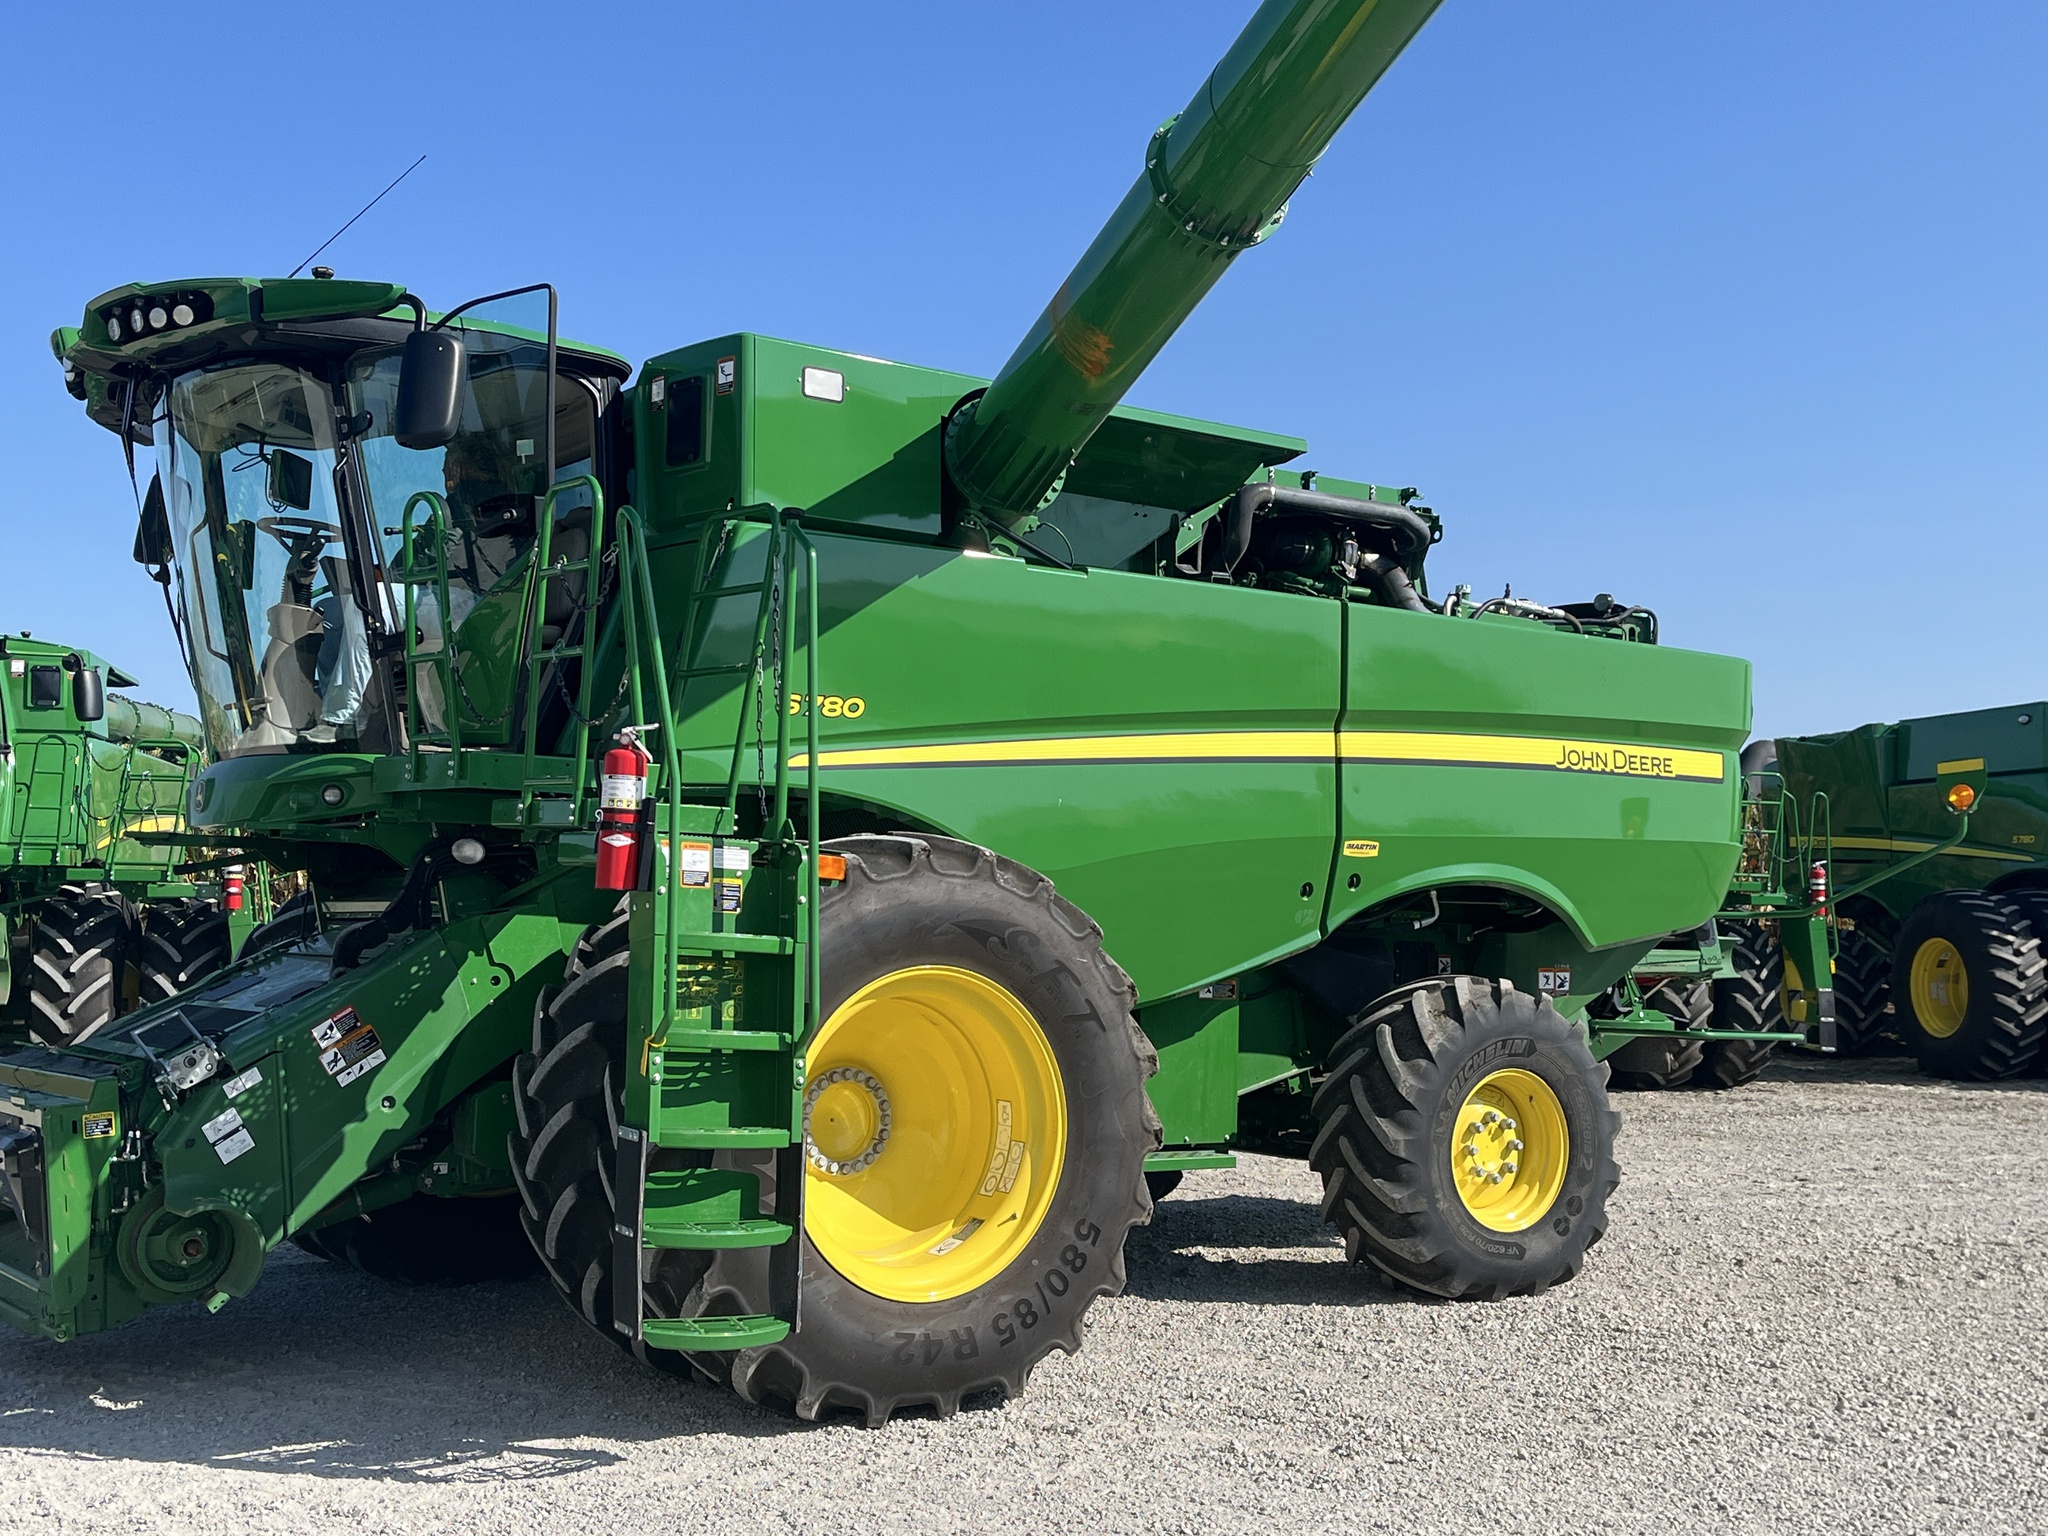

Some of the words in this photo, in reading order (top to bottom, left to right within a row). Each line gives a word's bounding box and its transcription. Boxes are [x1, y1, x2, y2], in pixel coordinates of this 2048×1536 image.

[1556, 745, 1608, 768] JOHN
[1612, 749, 1673, 773] DEERE
[2011, 834, 2035, 844] S780
[1447, 1039, 1528, 1103] MICHELIN
[1579, 1153, 1593, 1172] 2
[991, 1217, 1102, 1347] 580/85
[892, 1326, 980, 1367] R42
